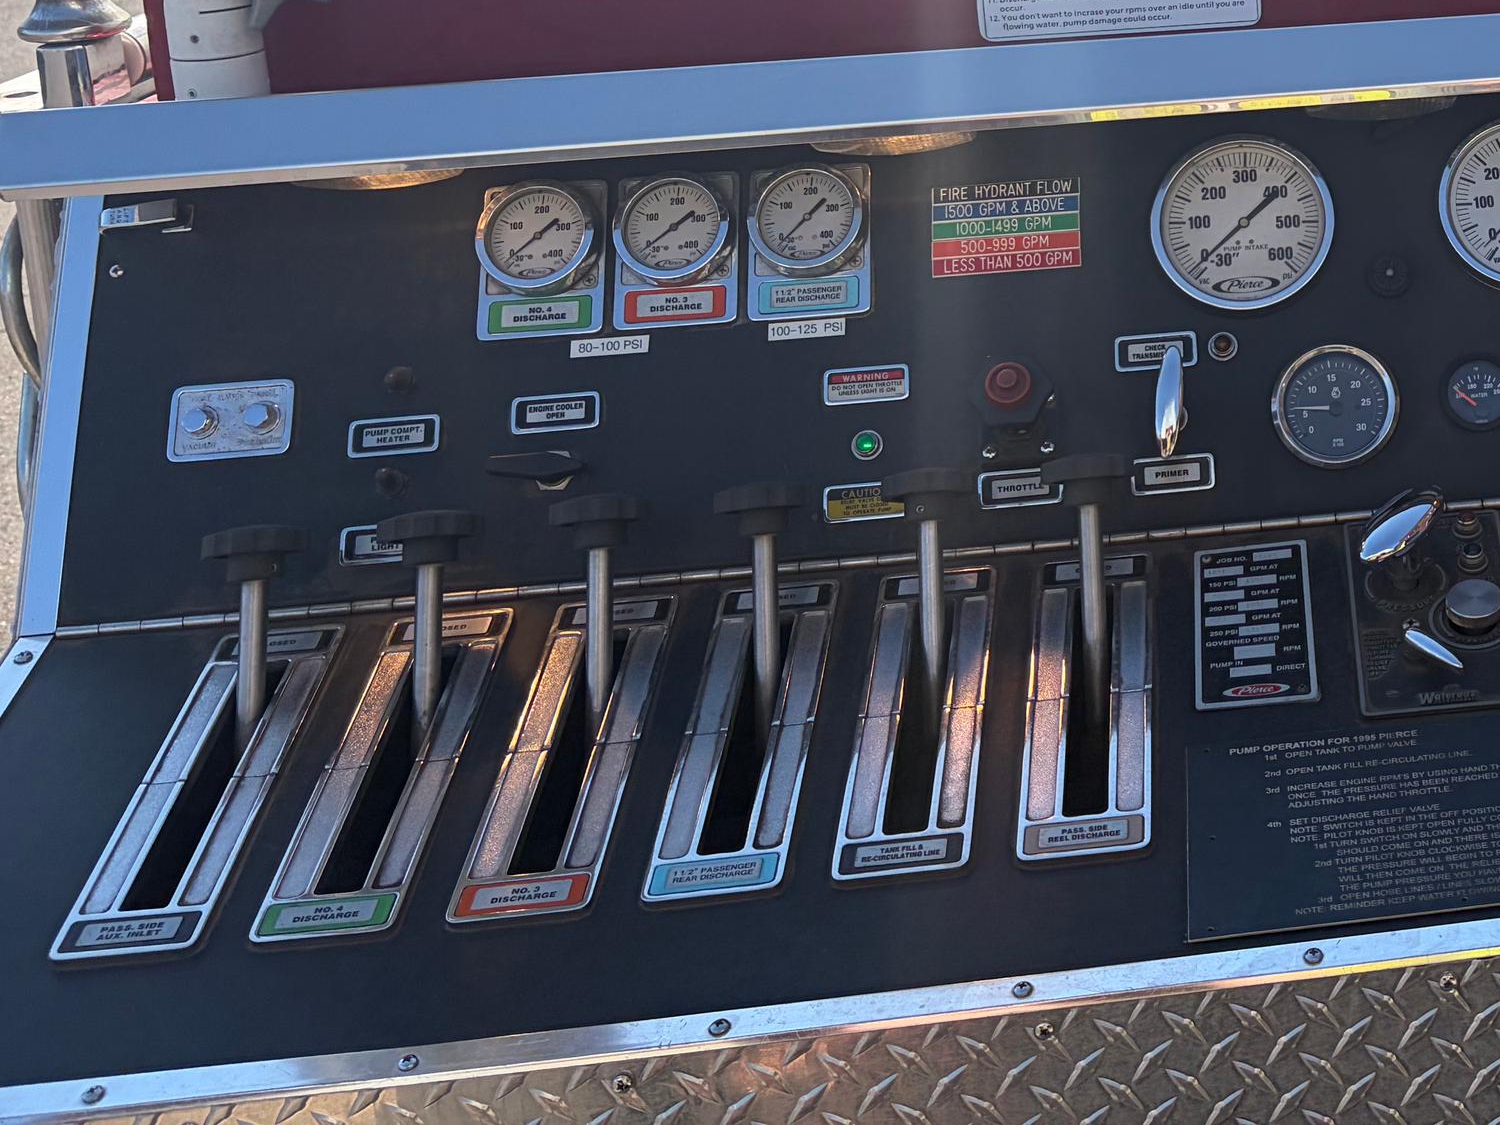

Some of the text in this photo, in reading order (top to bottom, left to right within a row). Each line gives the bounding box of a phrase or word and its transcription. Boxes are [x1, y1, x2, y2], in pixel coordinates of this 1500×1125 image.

[1232, 170, 1258, 183] 300
[940, 179, 1072, 201] FIRE HYDRANT FLOW
[1202, 186, 1226, 200] 200
[1263, 186, 1288, 199] 400
[1472, 194, 1495, 209] 100
[945, 197, 1065, 219] 1500 GPM & ABOVE
[956, 216, 1052, 235] 1000-1499 GPM
[1188, 215, 1210, 229] 100
[1275, 215, 1300, 228] 500
[961, 235, 1049, 254] 500-999 GPM
[1268, 246, 1294, 261] 600
[944, 251, 1072, 274] LESS THAN 500 GPM
[797, 286, 842, 295] PASSENGER
[1226, 278, 1265, 293] Pierce
[798, 293, 841, 302] DISCHARGE
[528, 306, 546, 314] NO.
[650, 303, 702, 313] DISCHARGE
[513, 313, 567, 323] DISCHARGE
[770, 322, 843, 337] 100-125 PSI
[578, 339, 643, 353] 80-100 PSI
[843, 372, 889, 383] WARNING
[1327, 373, 1337, 382] 15
[1307, 385, 1317, 394] 10
[1350, 380, 1361, 389] 20
[839, 389, 860, 397] UNLESS
[1361, 398, 1372, 406] 25
[528, 403, 584, 414] ENGINE COOLER
[546, 412, 565, 420] OPEN
[365, 426, 423, 437] PUMP COMPT.
[1356, 422, 1367, 431] 30
[376, 435, 410, 445] HEATER
[1155, 469, 1189, 479] PRIMER
[841, 488, 881, 499] CAUTIO
[1238, 685, 1274, 695] Pierce
[1230, 746, 1260, 756] PUMP
[1263, 739, 1324, 752] OPERATION
[1328, 736, 1350, 745] FOR
[1353, 734, 1376, 743] 1995
[1061, 824, 1108, 835] PASS. SIDE
[1048, 830, 1121, 843] REEL DISCHARGE
[902, 845, 917, 853] FILL
[862, 849, 940, 863] RE-CIRCULATING LINE
[512, 887, 533, 895] NO.
[490, 891, 557, 904] DISCHARGE
[315, 906, 335, 914] NO.
[292, 910, 360, 923] DISCHARGE
[100, 921, 164, 933] PASS. SIDE
[96, 929, 161, 941] AUX. INLET
